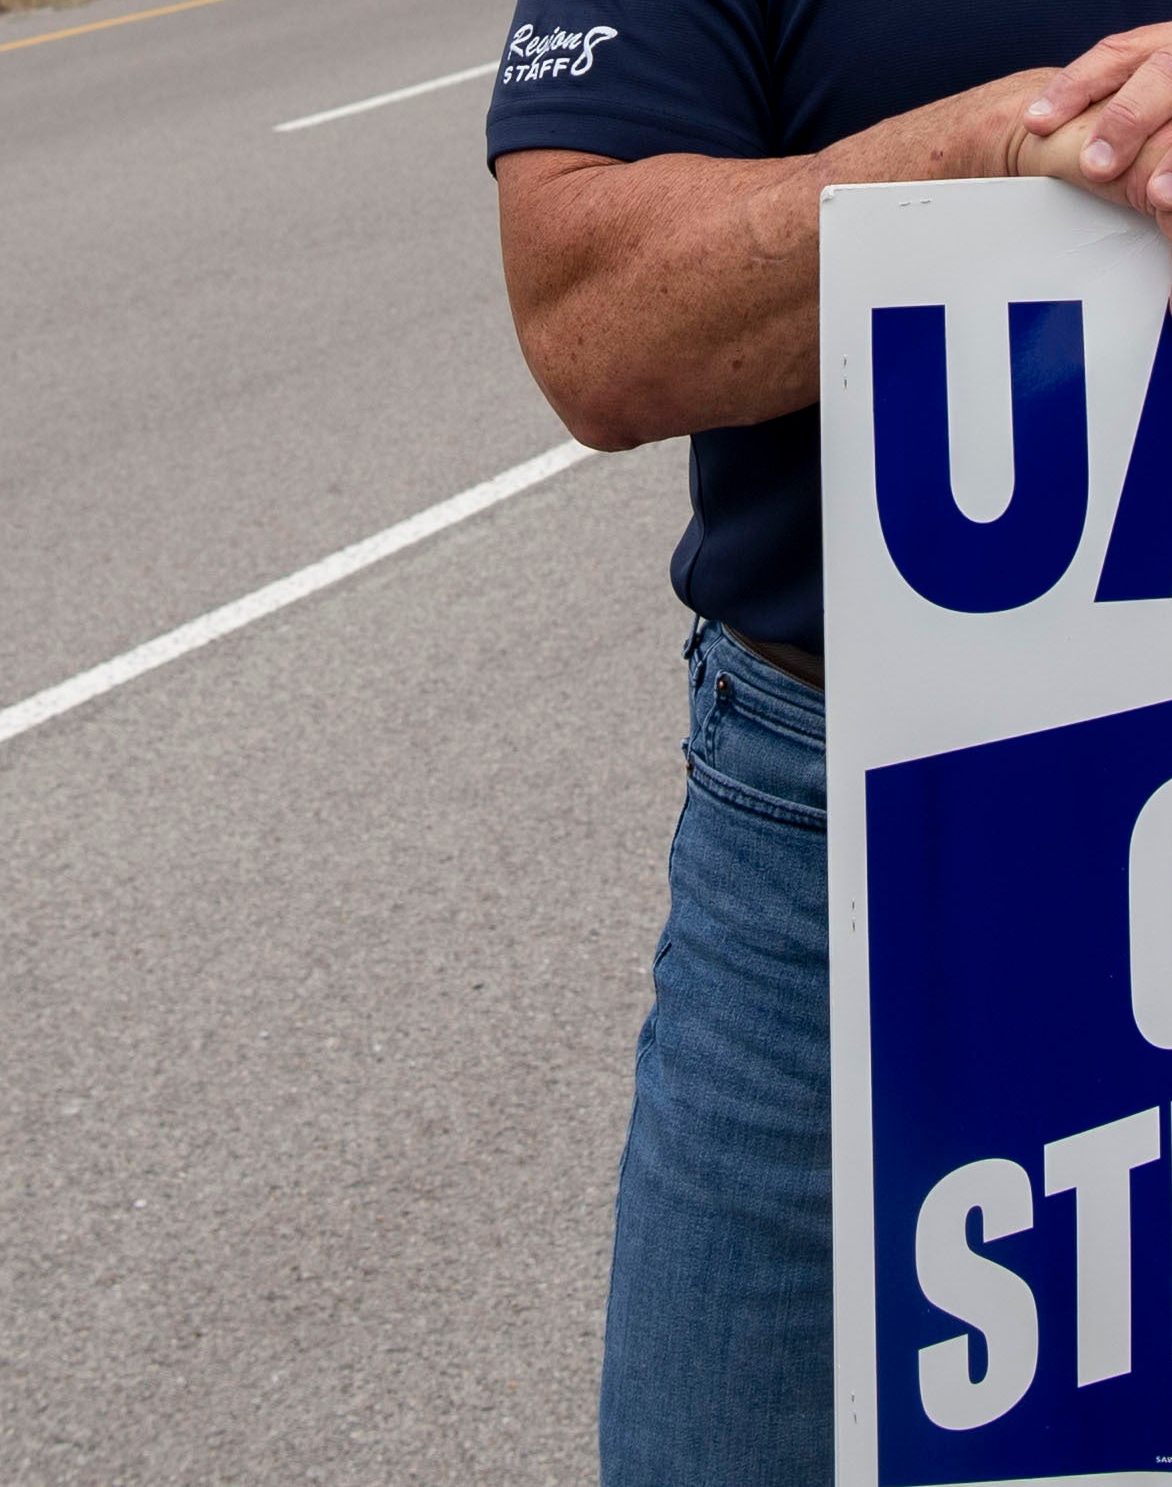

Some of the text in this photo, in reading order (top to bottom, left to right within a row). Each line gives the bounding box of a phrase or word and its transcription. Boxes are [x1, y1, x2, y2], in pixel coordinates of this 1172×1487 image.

[507, 23, 619, 77] Region 8
[503, 57, 571, 85] STAFF
